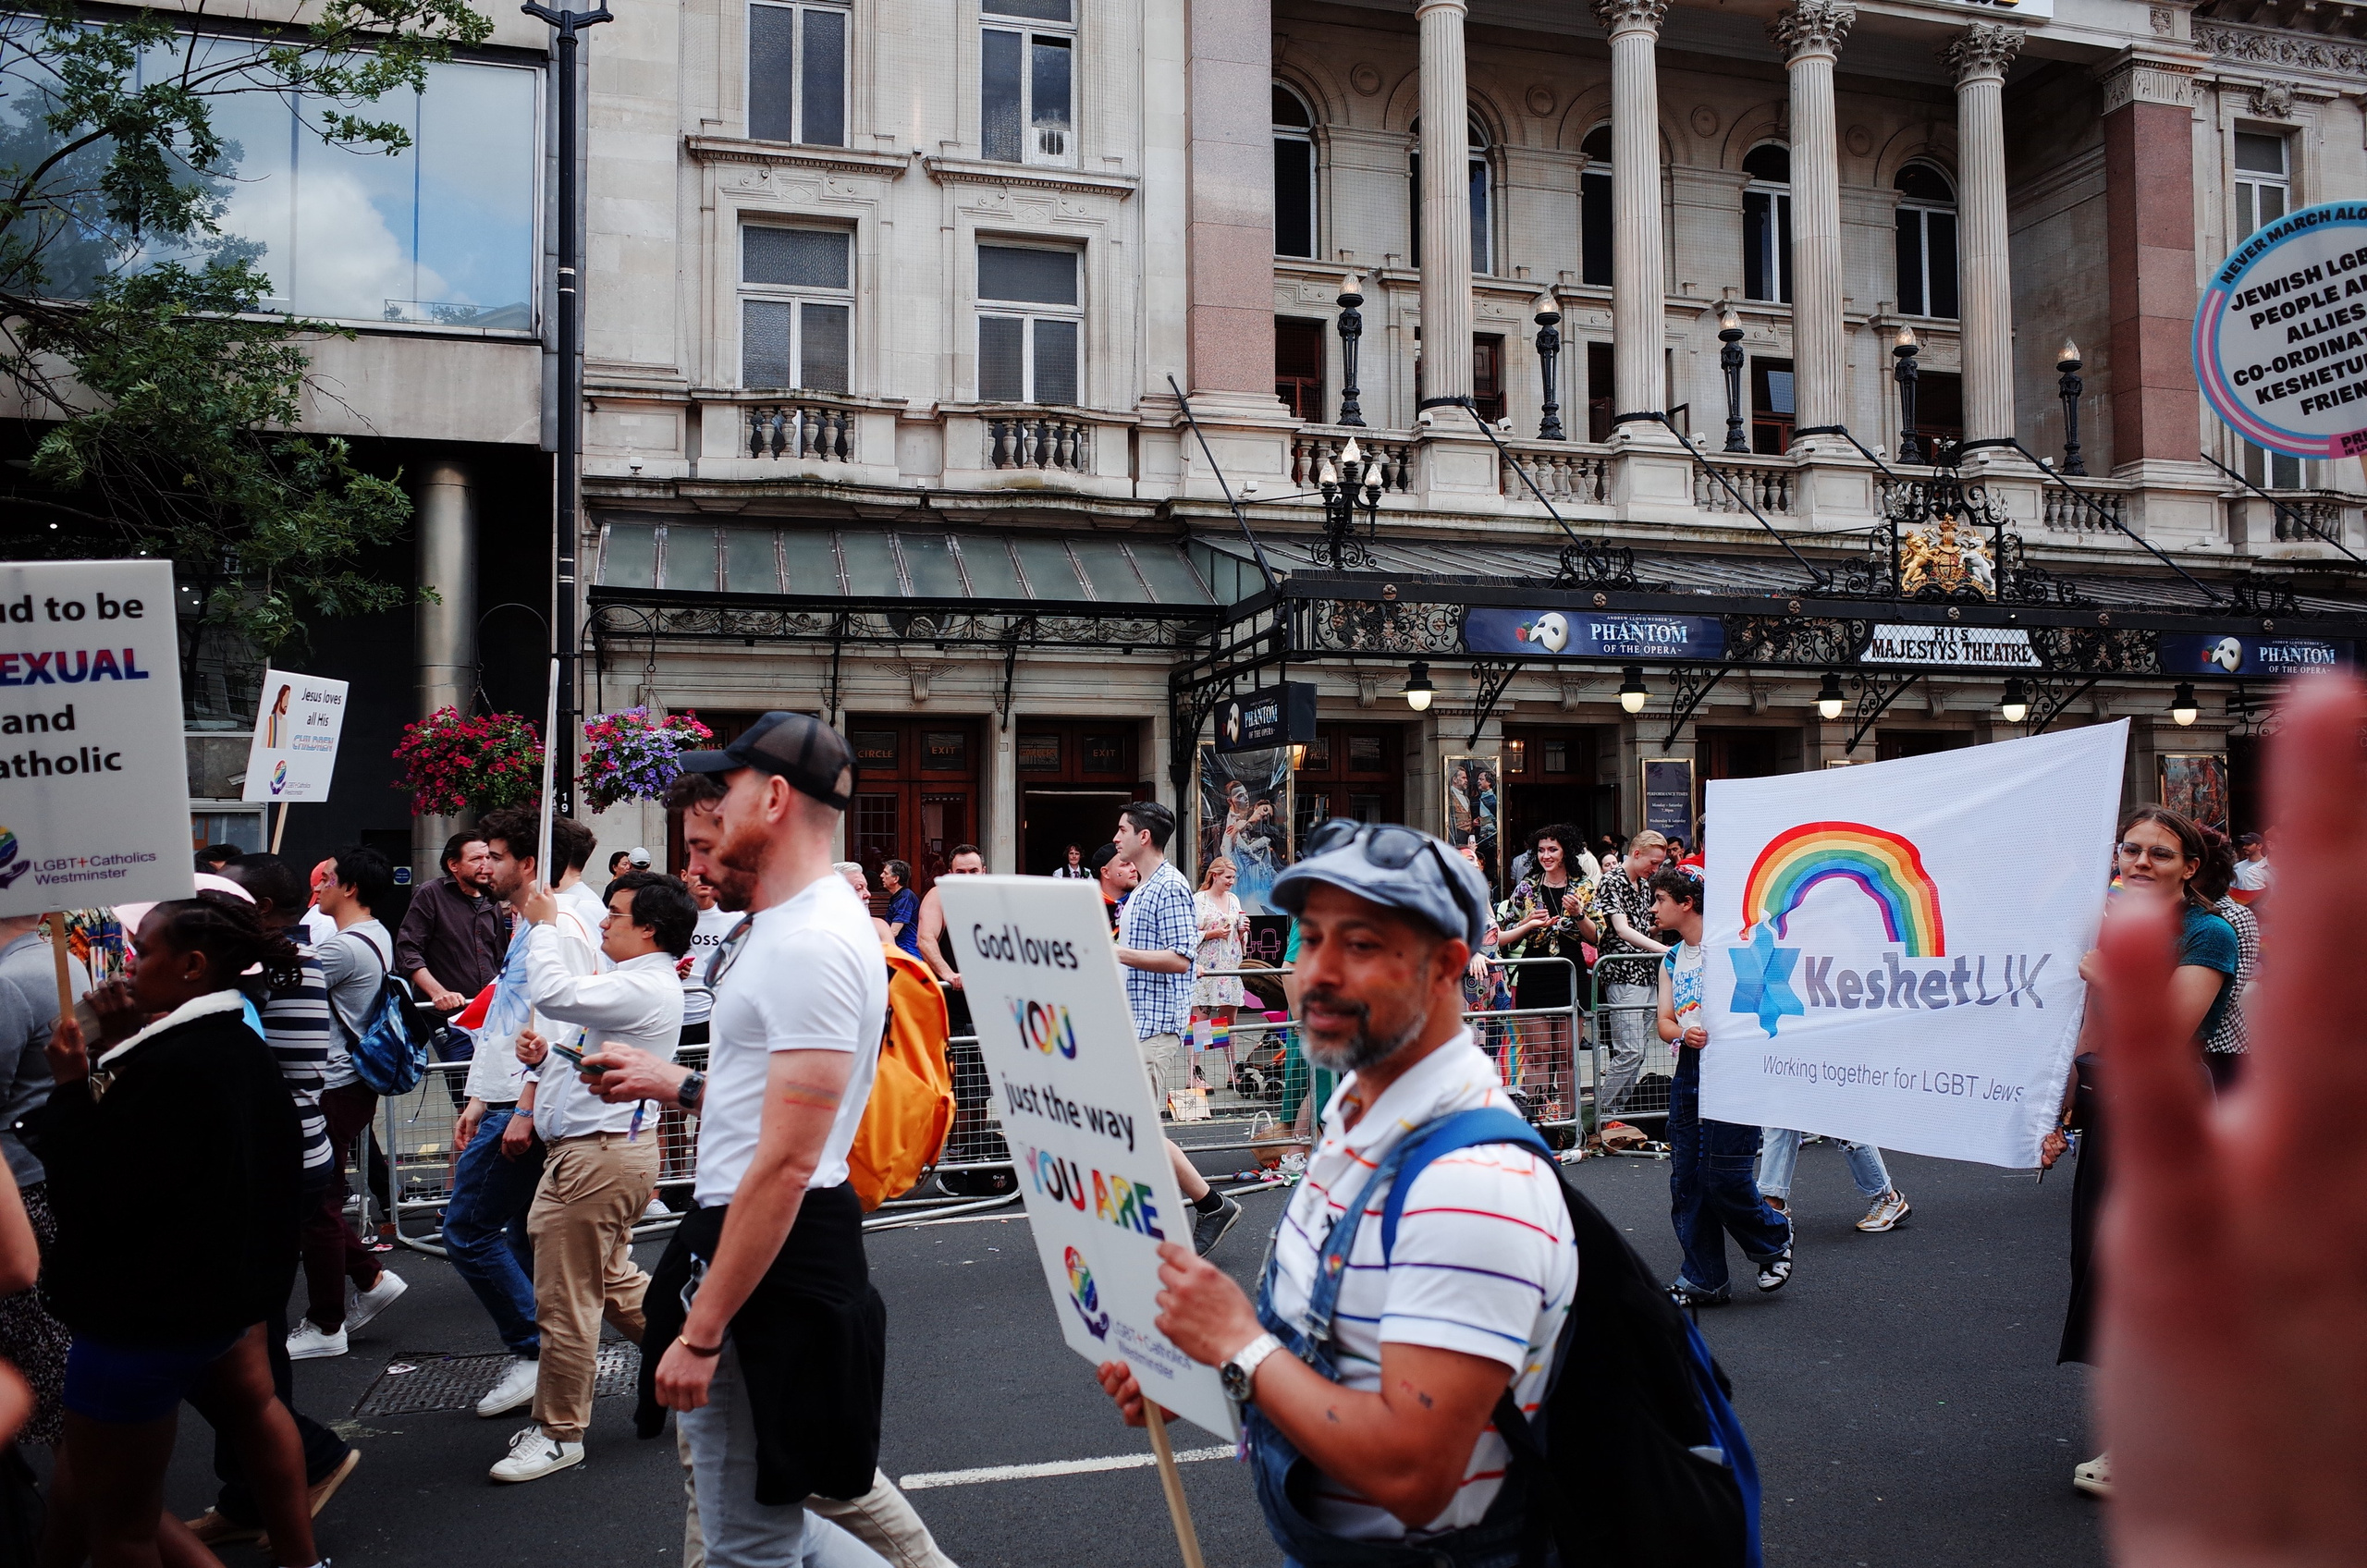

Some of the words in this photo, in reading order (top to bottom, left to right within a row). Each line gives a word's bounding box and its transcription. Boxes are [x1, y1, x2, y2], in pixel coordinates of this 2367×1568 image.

[2220, 238, 2268, 285] NEVER
[2266, 209, 2332, 243] MARCH
[2335, 206, 2367, 221] ALO
[2231, 264, 2324, 312] JEWISH
[2325, 247, 2367, 277] LGB
[2250, 285, 2341, 330] PEOPLE
[2287, 302, 2367, 344] ALLIES
[2300, 379, 2367, 416] FRIEN
[44, 597, 86, 622] to
[96, 592, 143, 619] be
[1590, 621, 1688, 643] PHANTOM
[1934, 628, 1968, 641] HIS
[1603, 644, 1617, 653] OF
[1620, 644, 1640, 654] THE
[1643, 645, 1676, 655] OPERA
[1963, 642, 2031, 662] THEATRE
[2259, 645, 2336, 665] PHANTOM
[0, 648, 149, 686] EXUAL
[2268, 665, 2279, 673] OF
[2282, 666, 2298, 674] THE
[2300, 667, 2326, 675] OPERA
[301, 688, 322, 703] Jesus
[323, 690, 341, 704] loves
[1, 704, 75, 734] and
[306, 712, 316, 726] all
[316, 713, 329, 726] His
[1245, 704, 1278, 728] PHANTOM
[1248, 731, 1254, 740] OF
[1261, 727, 1274, 737] OPERA
[857, 750, 893, 758] CIRCLE
[931, 746, 956, 754] EXIT
[1093, 749, 1115, 757] EXIT
[33, 851, 156, 873] LGBT+Catholics
[34, 868, 128, 886] Westminster
[974, 924, 1015, 962] God
[1014, 925, 1078, 970] loves
[1004, 995, 1076, 1060] YOU
[1763, 1055, 1817, 1084] Working
[1821, 1060, 1889, 1087] together
[1894, 1067, 1917, 1090] for
[1922, 1070, 1980, 1097] LGBT
[1982, 1078, 2025, 1103] Jews
[1000, 1072, 1044, 1116] just
[1042, 1084, 1082, 1129] the
[1084, 1105, 1134, 1152] way
[1019, 1140, 1086, 1212] YOU
[1091, 1169, 1165, 1242] ARE
